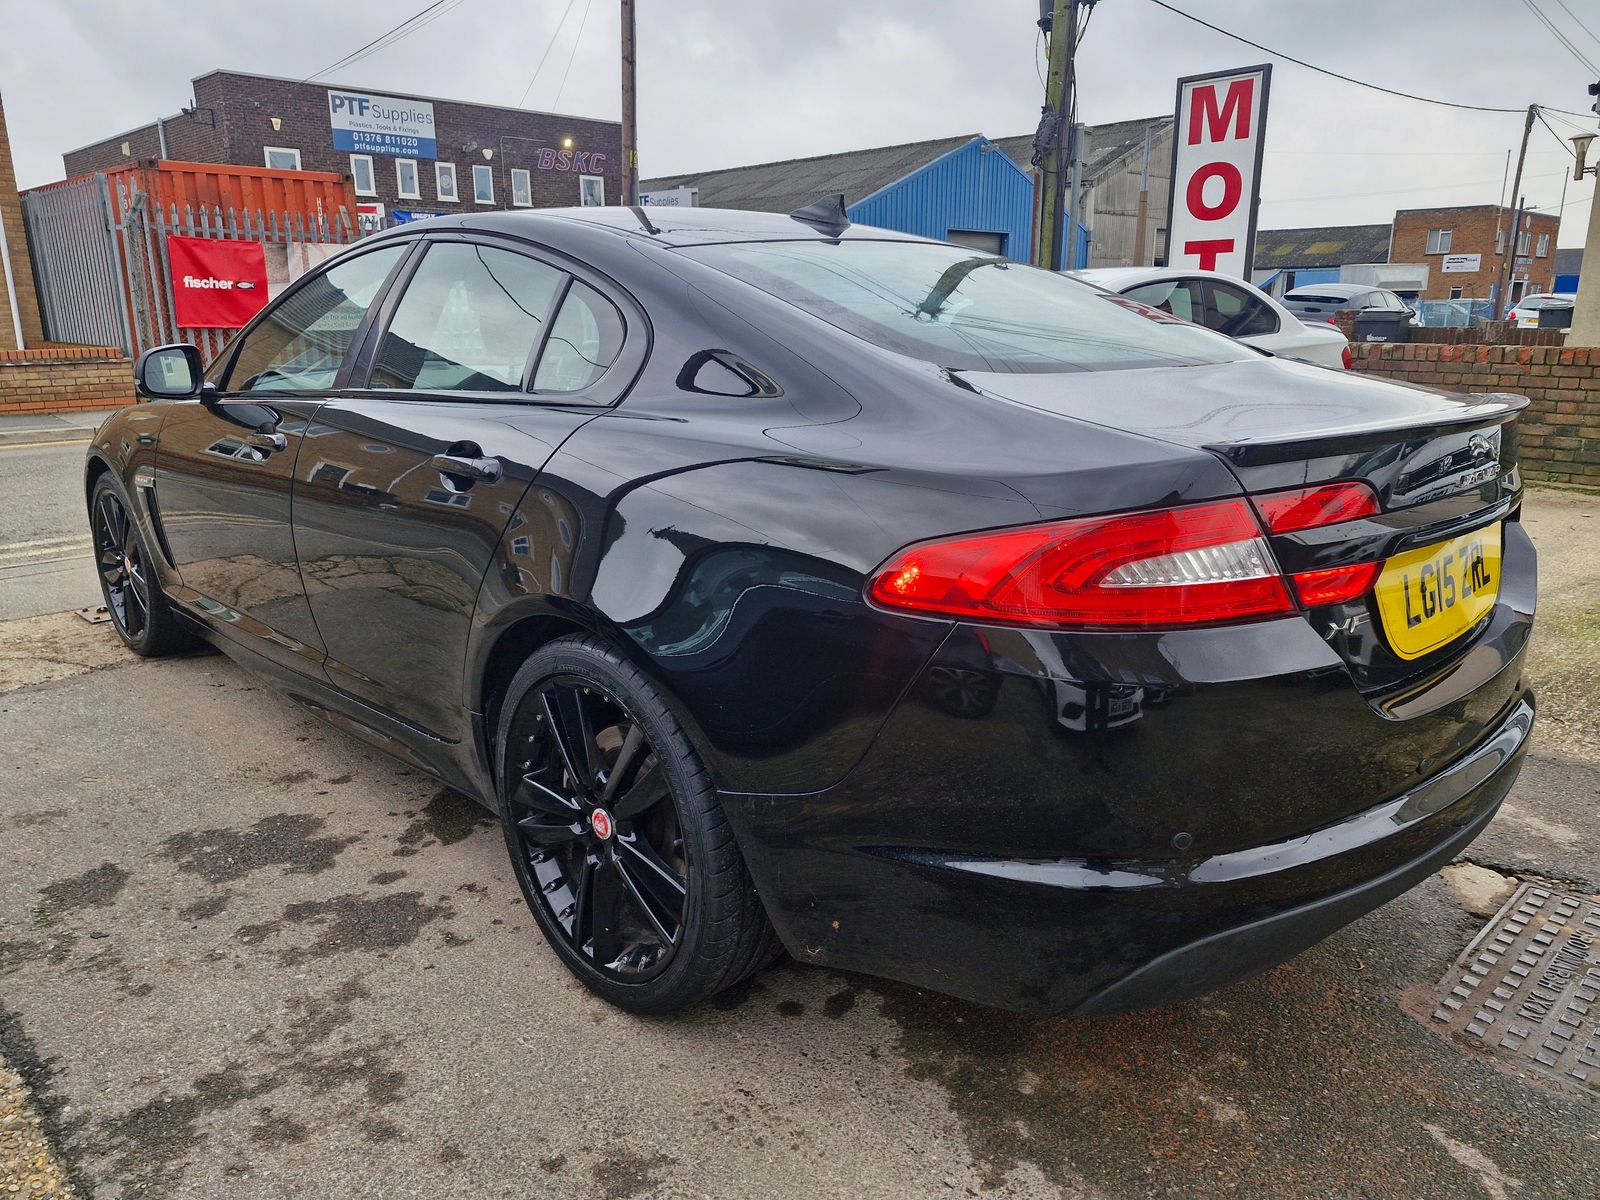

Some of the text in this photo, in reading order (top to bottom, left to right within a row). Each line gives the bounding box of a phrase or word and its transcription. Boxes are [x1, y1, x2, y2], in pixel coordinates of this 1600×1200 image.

[330, 94, 433, 125] PTF Supplies
[376, 123, 391, 132] Tools
[398, 126, 419, 134] Fixings
[353, 132, 418, 146] 01376 811020
[354, 143, 419, 155] ptfsupplies.com
[537, 148, 606, 173] BSKC
[1184, 78, 1254, 272] MOT
[639, 195, 650, 206] TF
[183, 275, 233, 290] fischer
[1403, 537, 1491, 630] LG15 ZRL
